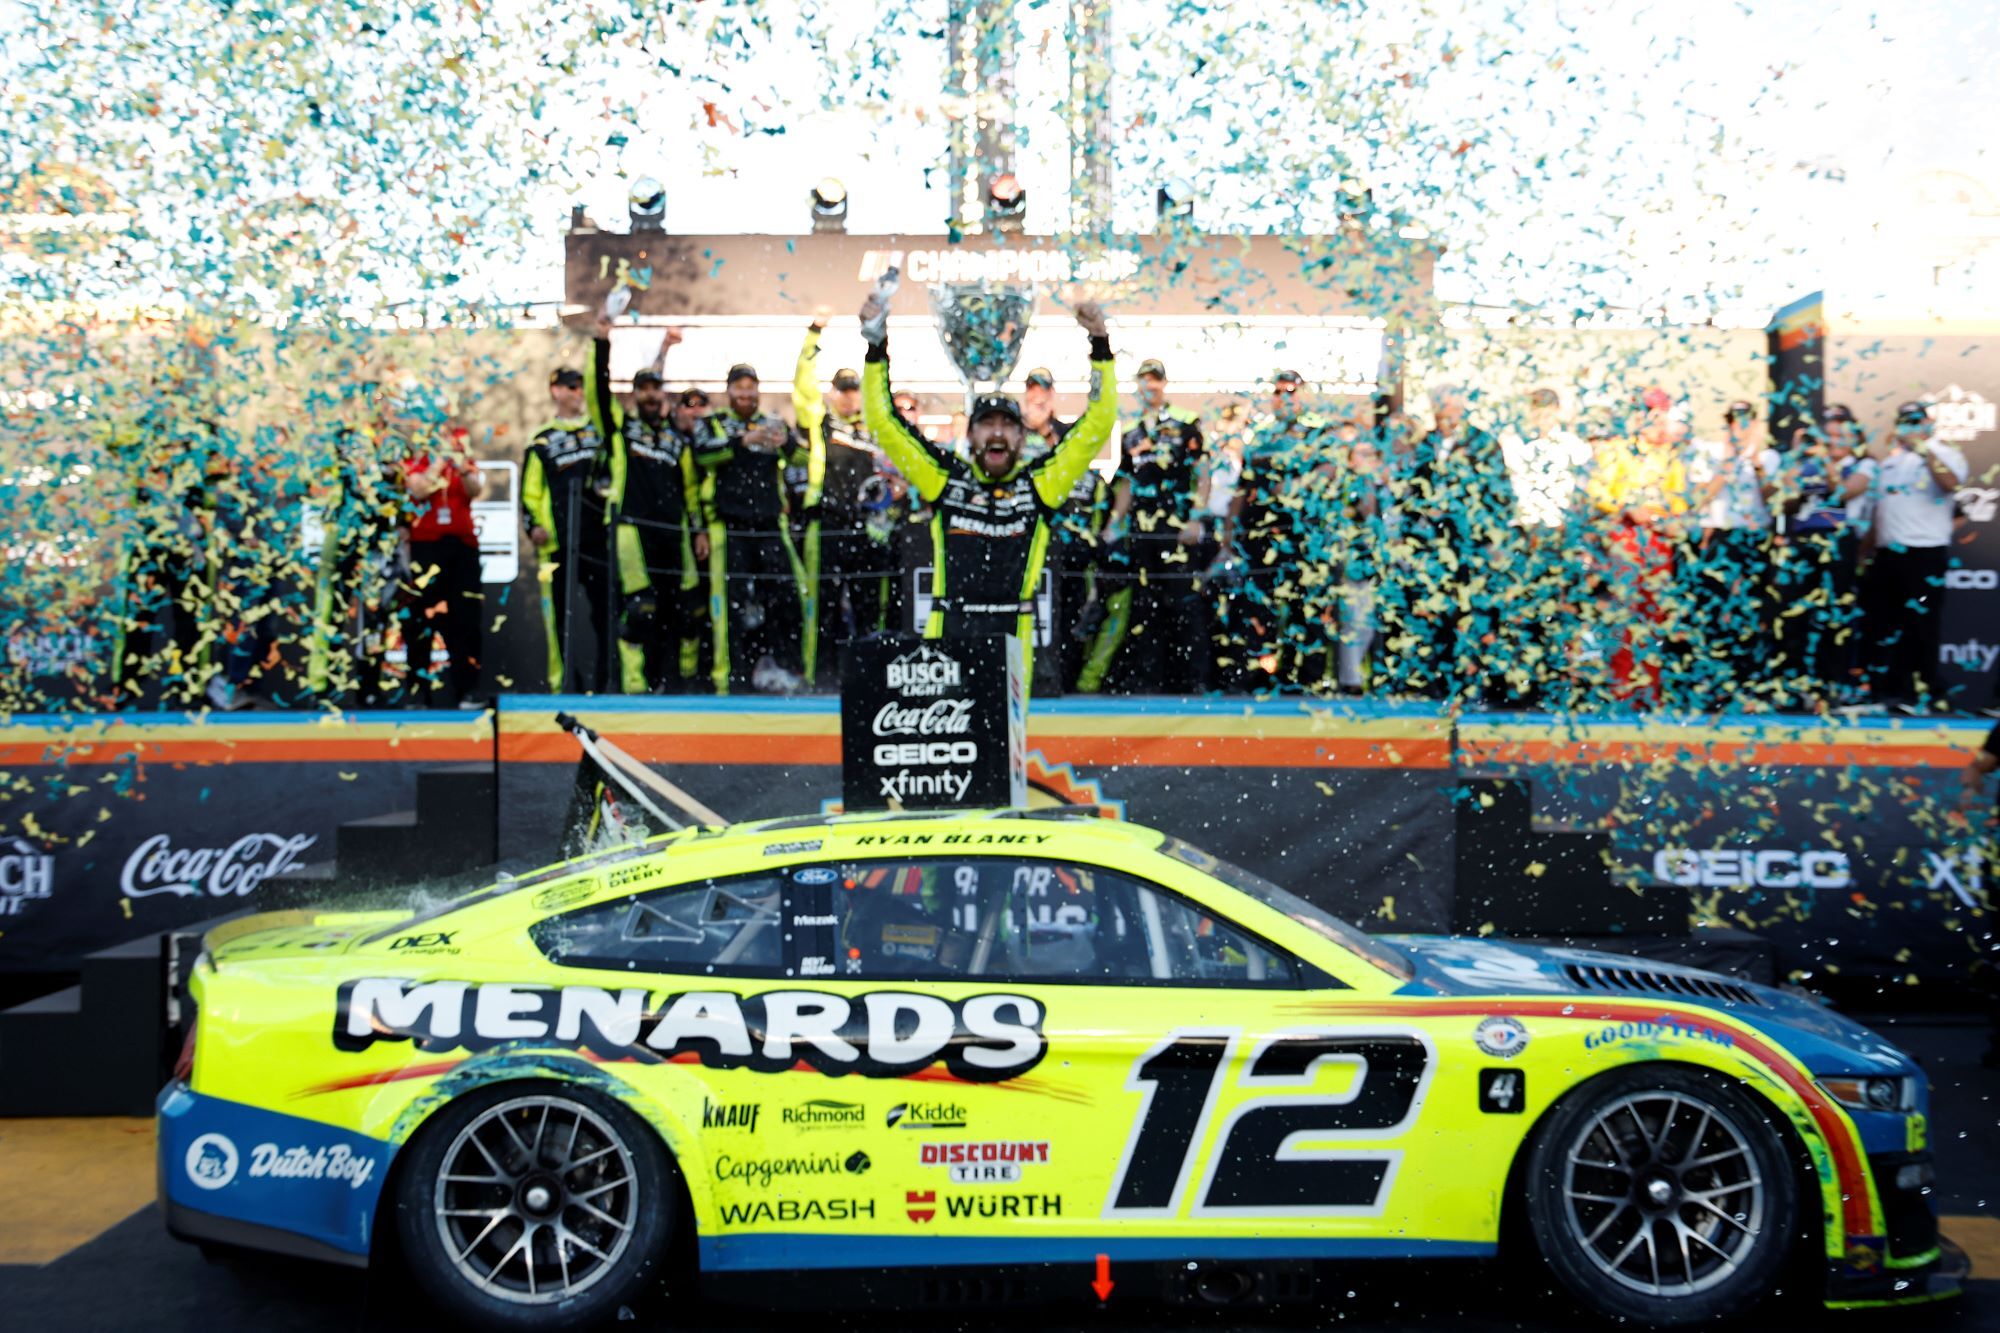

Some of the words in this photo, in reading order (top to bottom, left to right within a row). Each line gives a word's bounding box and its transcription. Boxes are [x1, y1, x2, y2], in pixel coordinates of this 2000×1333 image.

[1945, 570, 1998, 588] ICO
[1939, 640, 2000, 672] nity
[886, 661, 961, 688] BUSCH
[902, 684, 945, 697] LIGHT
[872, 698, 976, 736] Coca-Cola
[873, 741, 978, 766] GEICO
[880, 769, 973, 802] xfinity
[856, 835, 933, 846] RYAN
[942, 834, 1052, 845] BLANEY
[120, 832, 318, 897] Coca-Col
[1653, 850, 1849, 887] GEICO
[389, 929, 460, 950] DEX
[340, 976, 1045, 1073] MENARDS
[1487, 1072, 1518, 1109] 4
[703, 1097, 760, 1133] KNAUF
[782, 1103, 865, 1124] Richmond
[910, 1102, 967, 1121] Kidde
[1102, 1027, 1437, 1218] 12
[249, 1142, 329, 1180] Dutch
[326, 1143, 375, 1189] Boy
[921, 1142, 1049, 1164] DISCOUNT
[716, 1151, 843, 1187] Capgemini
[957, 1166, 1012, 1180] TIRE
[720, 1199, 875, 1225] WABASH
[947, 1194, 1062, 1218] WÜRTH
